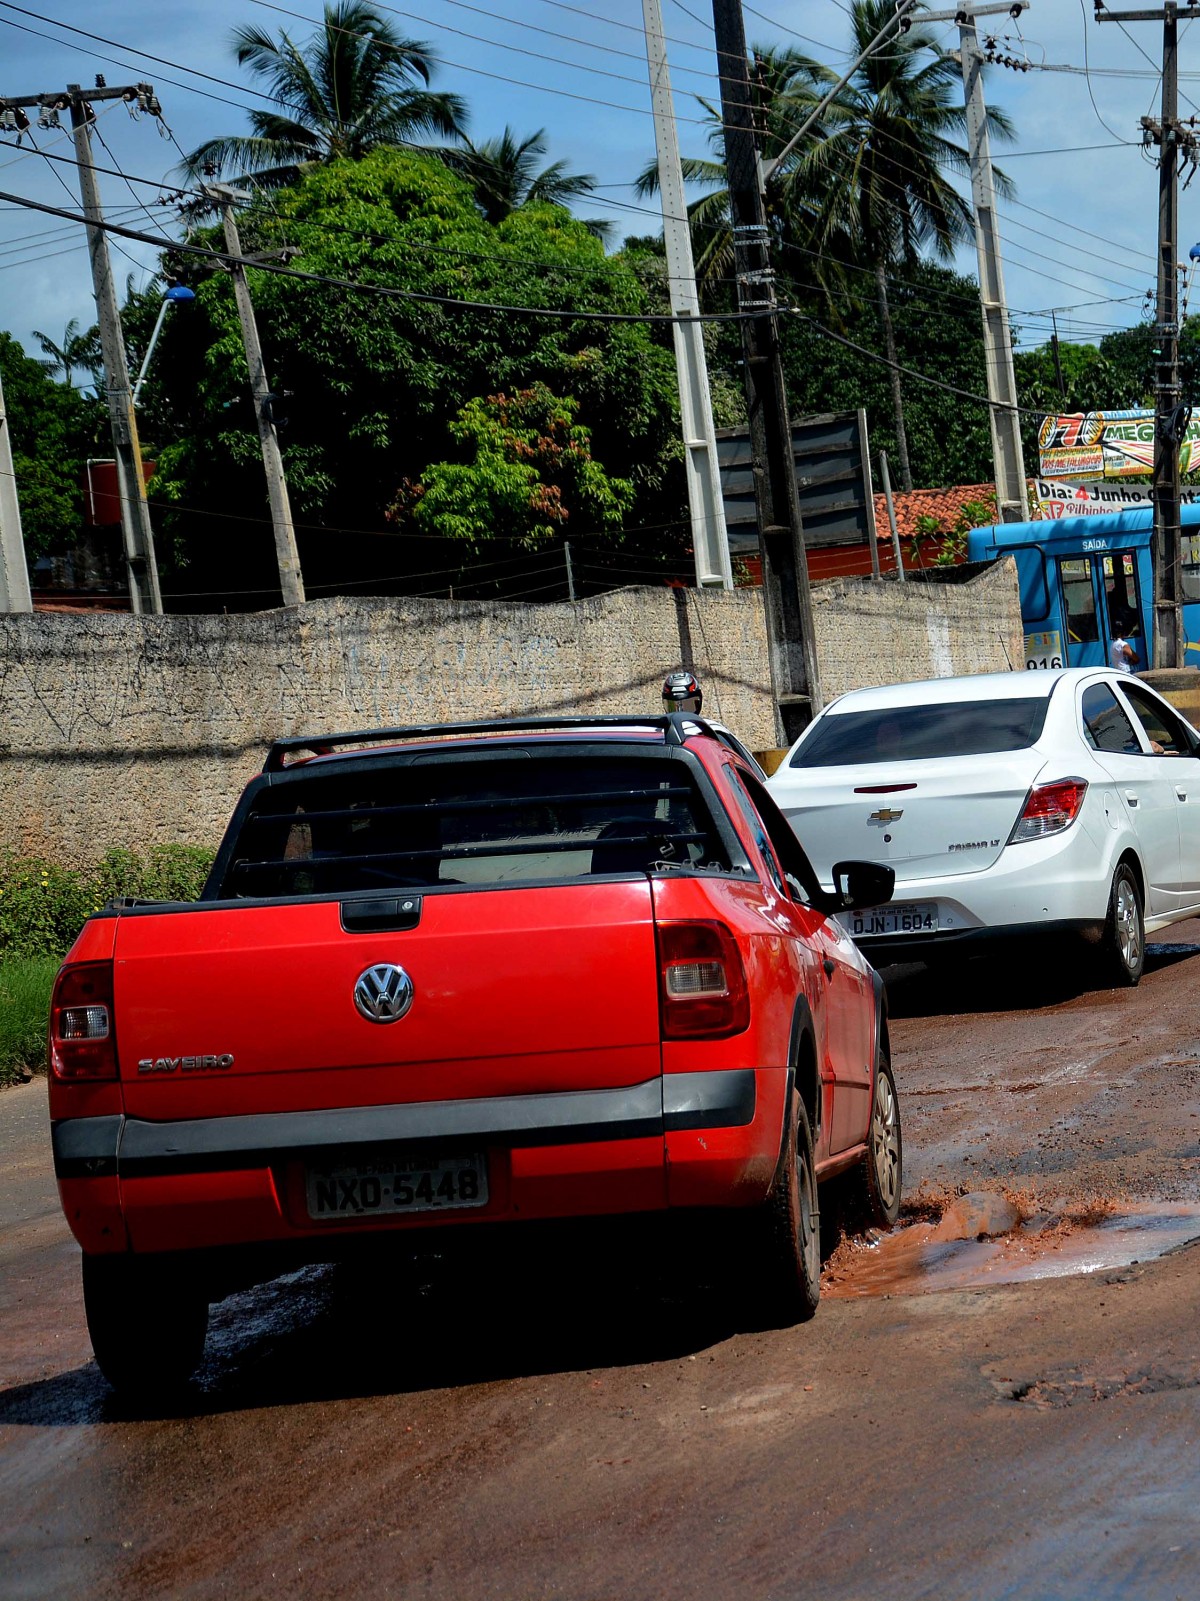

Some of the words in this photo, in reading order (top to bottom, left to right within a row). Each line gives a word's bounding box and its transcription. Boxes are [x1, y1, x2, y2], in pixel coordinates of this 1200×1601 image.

[1056, 413, 1086, 447] 7
[1105, 423, 1154, 442] MEG
[1038, 483, 1072, 499] Dia:
[1075, 486, 1089, 501] 4
[1082, 538, 1108, 550] SAÍDA
[948, 840, 988, 852] PRISMA
[990, 839, 1000, 848] LT
[138, 1054, 235, 1071] SAVEIRO
